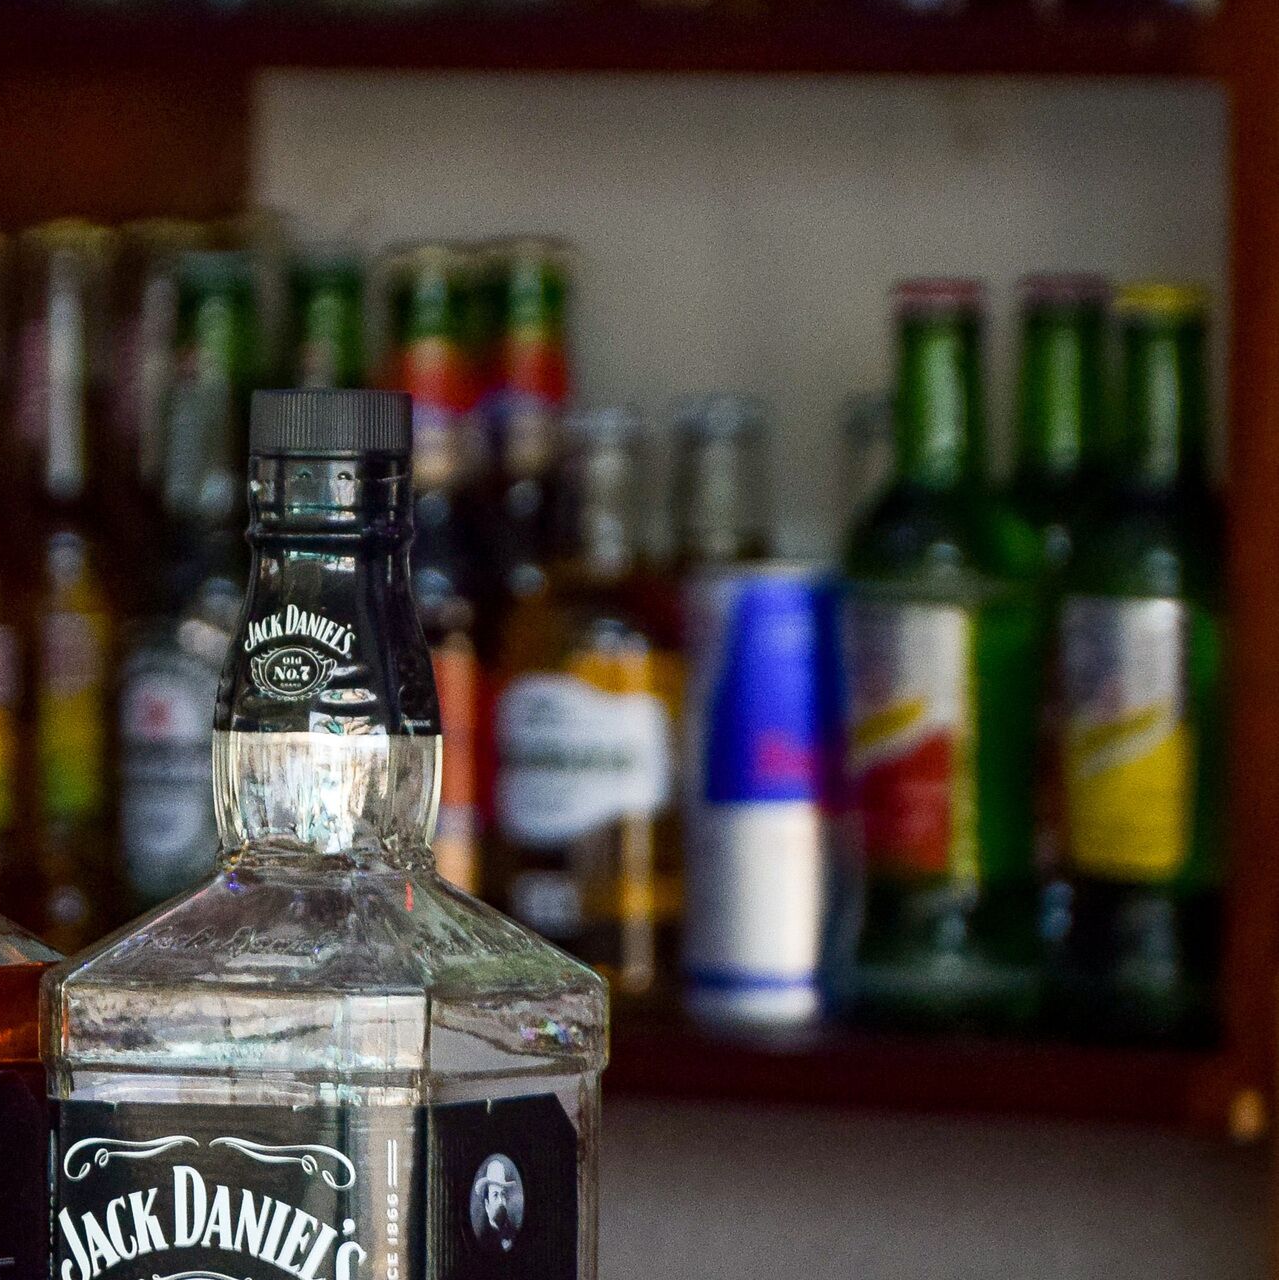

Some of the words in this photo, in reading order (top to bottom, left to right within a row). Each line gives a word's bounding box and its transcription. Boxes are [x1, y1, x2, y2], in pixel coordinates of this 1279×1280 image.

[244, 612, 283, 652] JACK
[285, 604, 356, 655] DANIEL'S
[282, 656, 302, 665] Old
[387, 1192, 399, 1244] 1866
